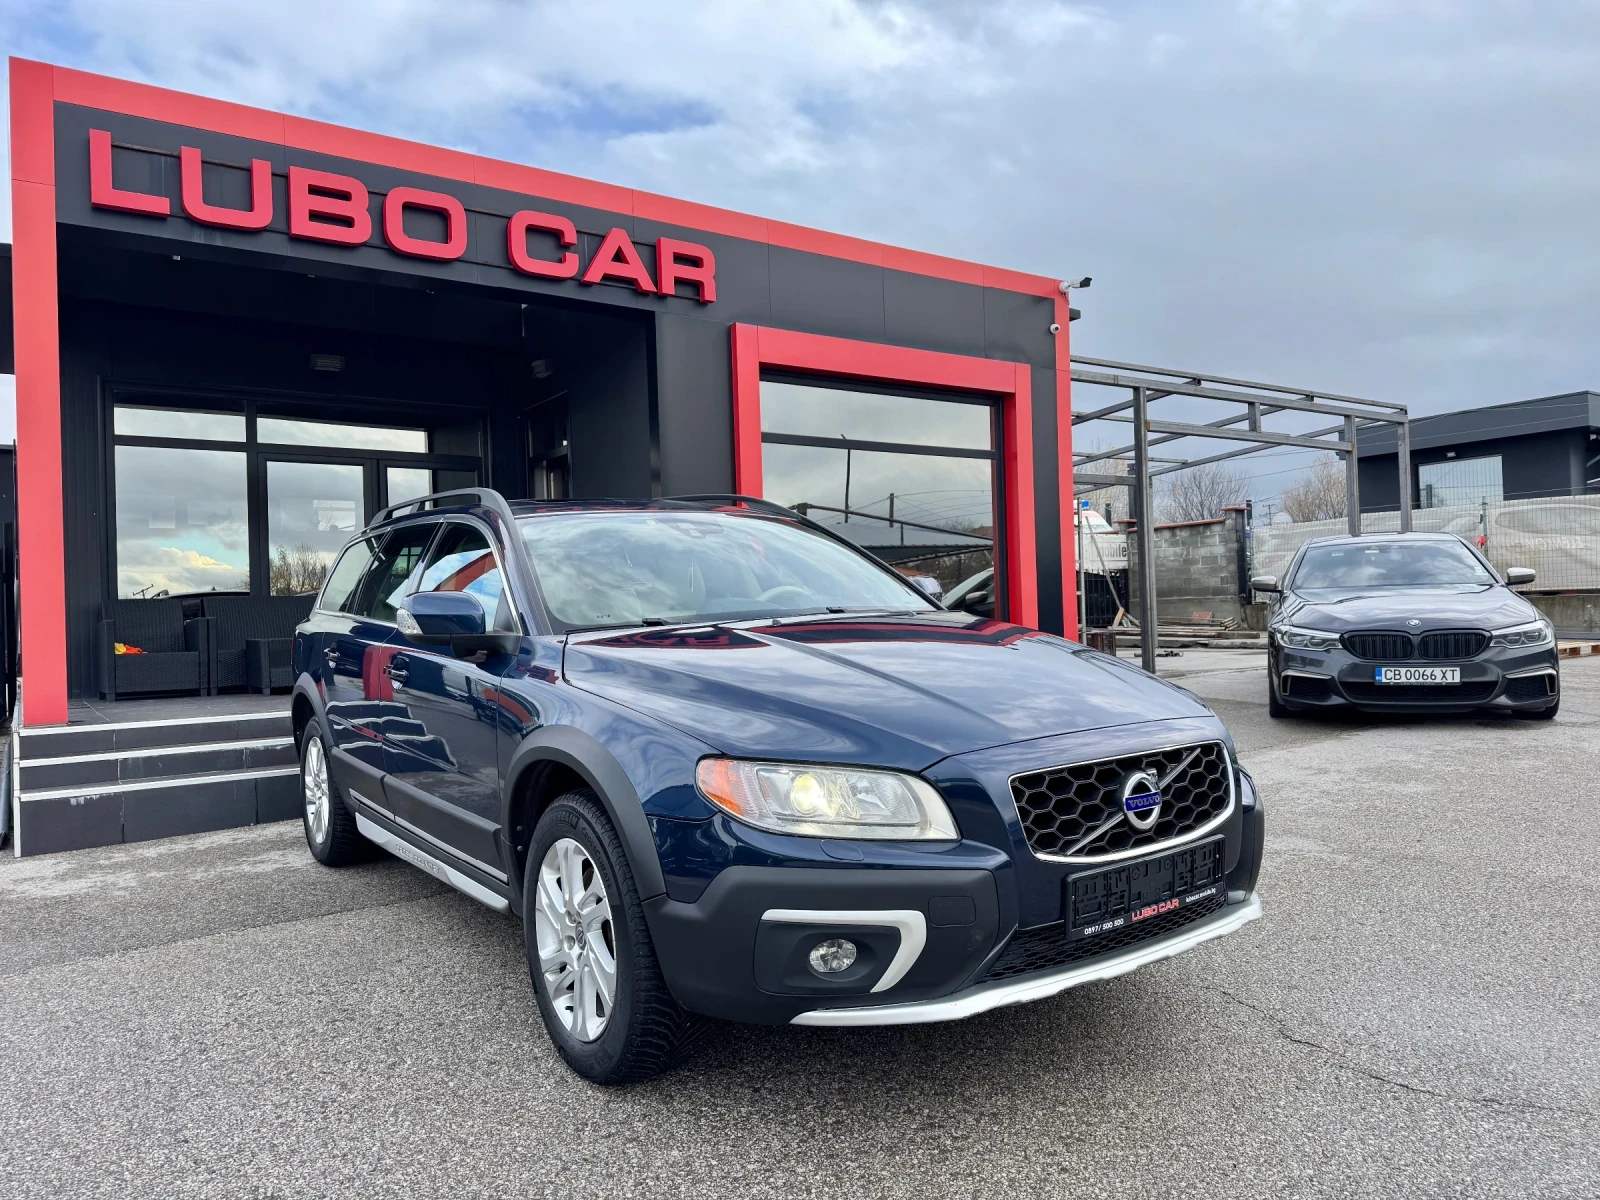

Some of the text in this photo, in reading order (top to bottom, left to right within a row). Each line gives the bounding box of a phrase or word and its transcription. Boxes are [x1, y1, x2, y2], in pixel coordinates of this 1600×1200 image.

[89, 128, 716, 304] LUBO CAR
[1384, 668, 1402, 681] CB
[1404, 669, 1437, 681] 0066
[1440, 669, 1458, 681] XT
[1127, 794, 1160, 808] VOLVO
[1131, 898, 1180, 922] LUBO CAR
[1102, 920, 1114, 930] 500
[1113, 918, 1124, 928] 500
